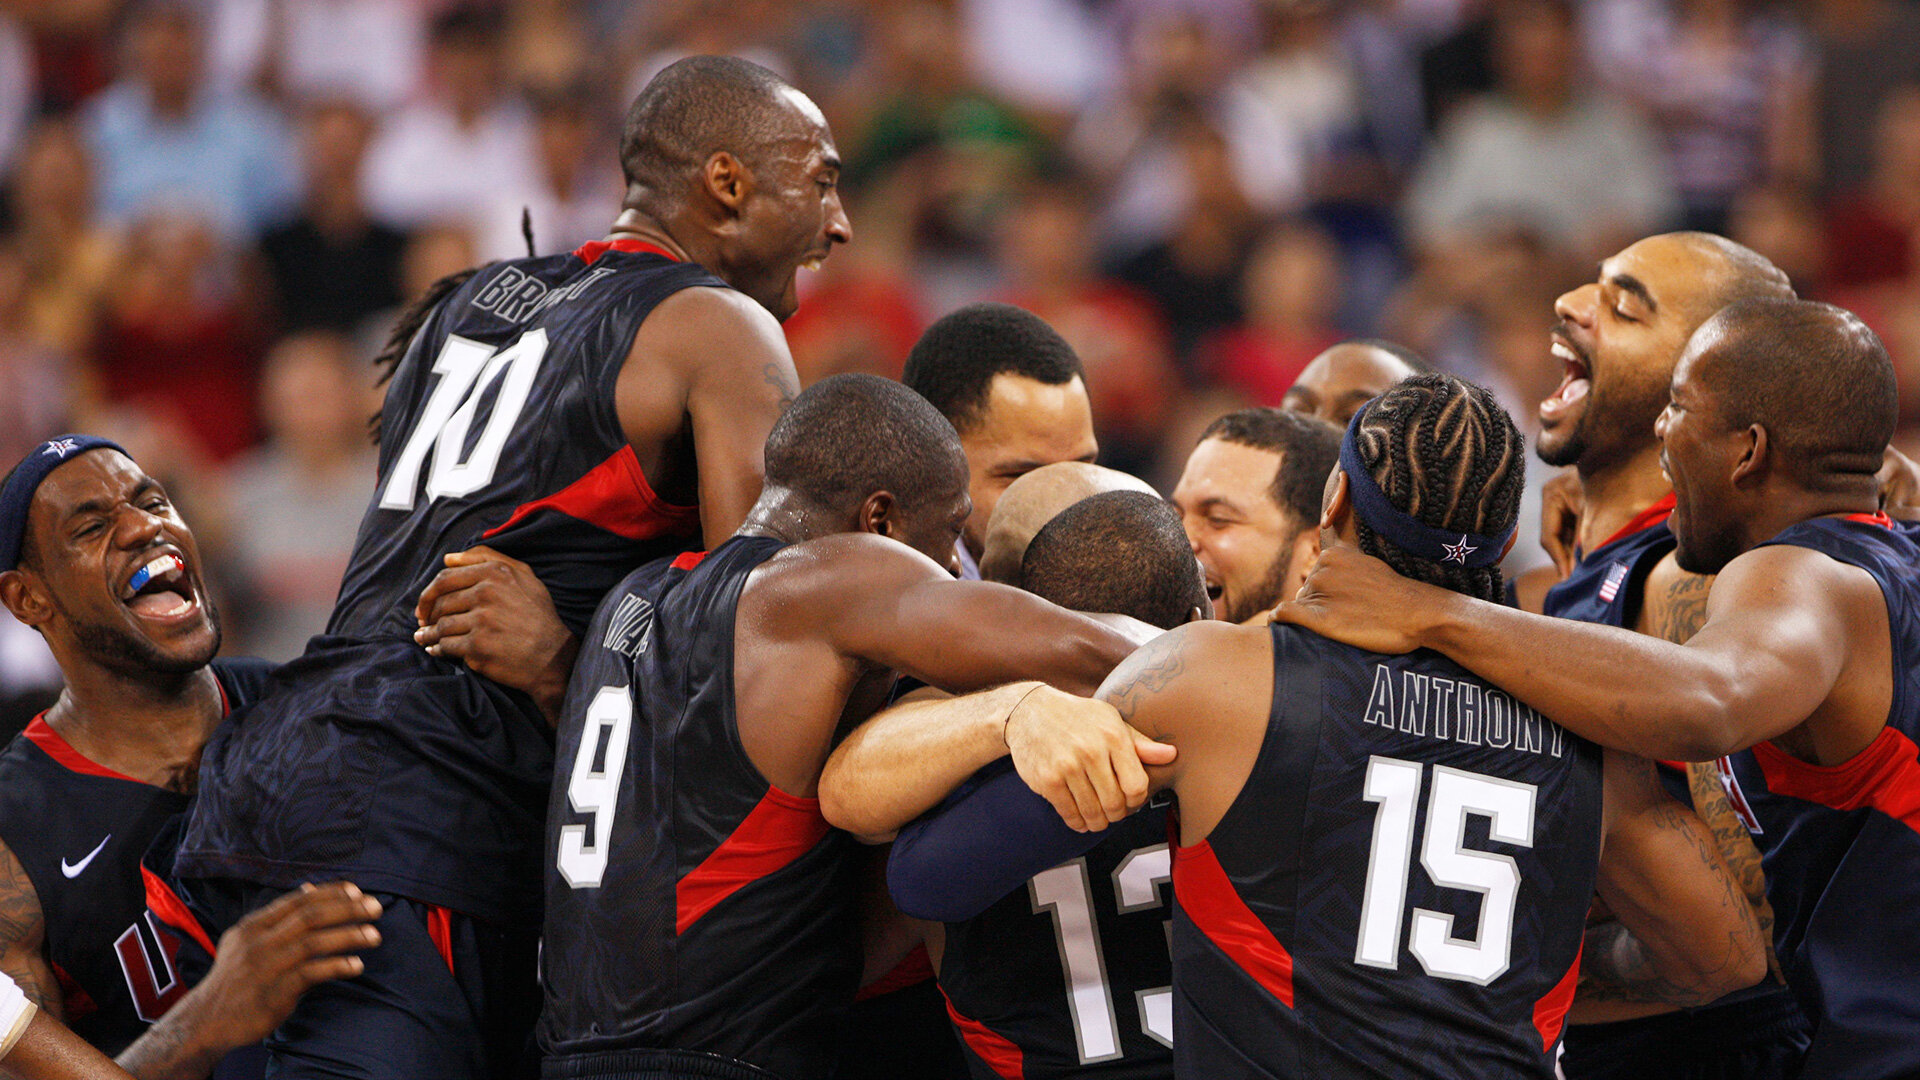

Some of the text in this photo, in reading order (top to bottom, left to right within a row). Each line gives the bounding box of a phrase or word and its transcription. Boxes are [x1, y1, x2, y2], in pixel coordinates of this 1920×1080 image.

[378, 327, 549, 511] 10
[556, 684, 633, 889] 9
[1354, 754, 1538, 987] 15
